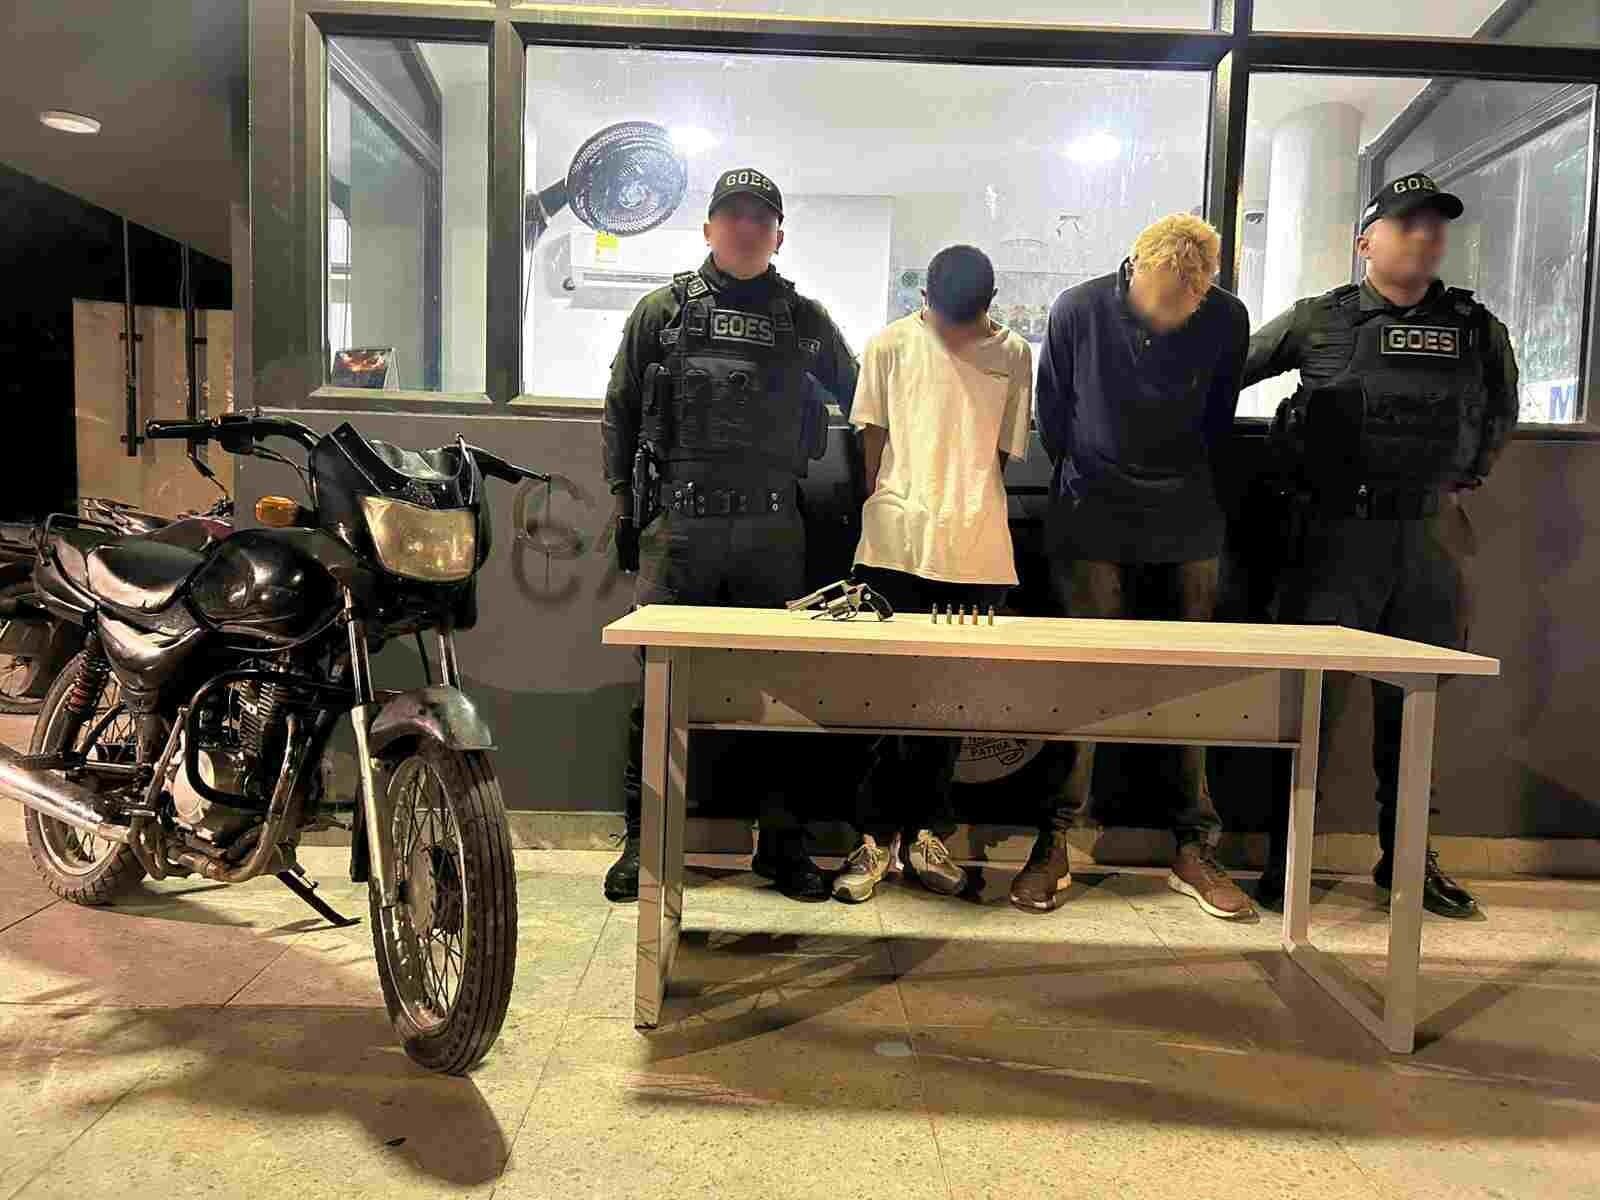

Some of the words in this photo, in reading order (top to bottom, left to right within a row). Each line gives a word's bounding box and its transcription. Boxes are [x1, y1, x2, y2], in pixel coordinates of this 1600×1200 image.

[726, 171, 771, 190] GOES
[714, 314, 772, 340] GOES
[1389, 329, 1455, 352] GOES
